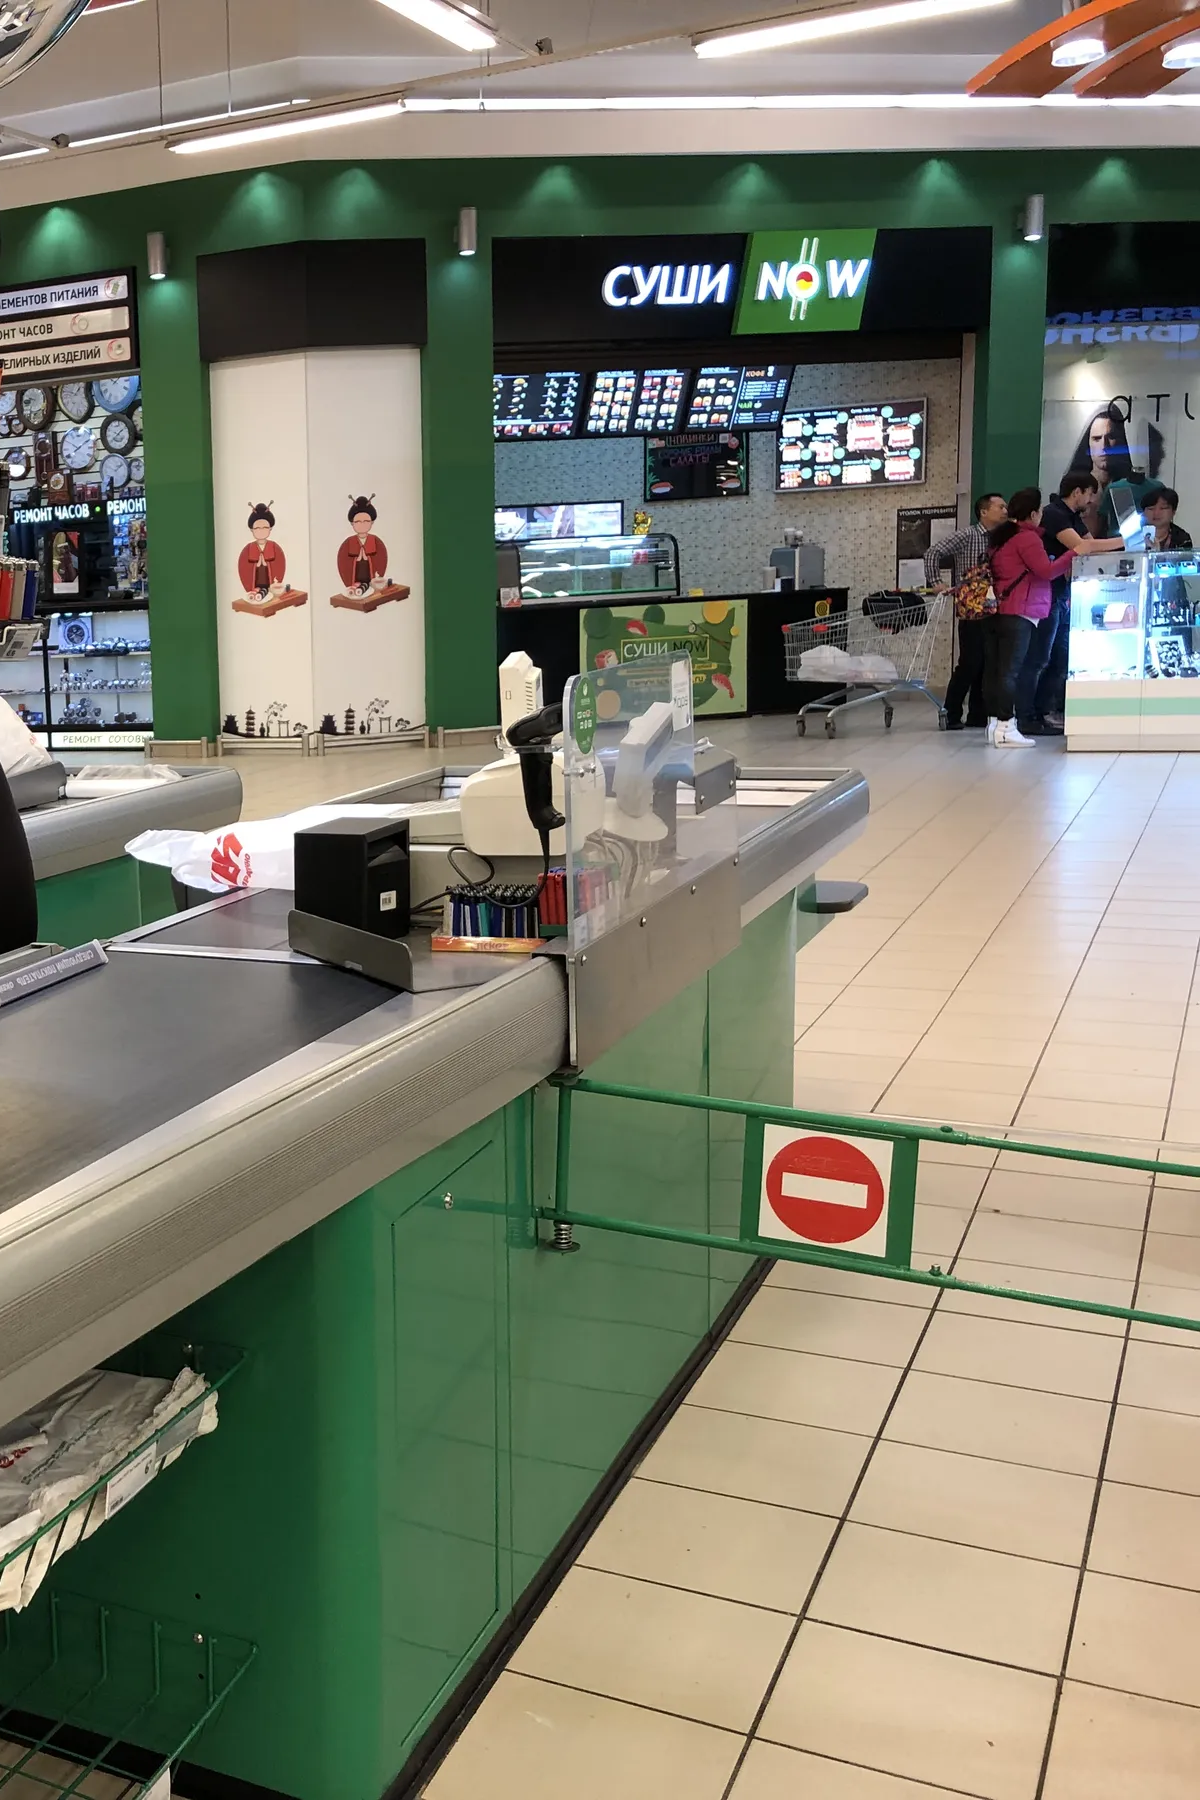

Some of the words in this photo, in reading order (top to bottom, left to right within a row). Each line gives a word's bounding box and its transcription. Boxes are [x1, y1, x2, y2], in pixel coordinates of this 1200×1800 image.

[602, 261, 731, 307] СУШИ
[755, 256, 870, 304] NOW
[50, 285, 99, 303] ПИТАНИЯ
[19, 323, 54, 337] ЧАСОВ
[53, 345, 101, 364] ИЗДЕЛИЙ
[13, 506, 53, 524] РЕМОНТ
[54, 503, 90, 520] ЧАСОВ
[623, 642, 668, 658] СУШИ
[672, 639, 708, 654] NOW
[62, 735, 101, 744] РЕМОНТ
[54, 950, 95, 975] СЛЕДУЮЩИЙ
[16, 963, 57, 986] ПОКУПАТЕЛЬ
